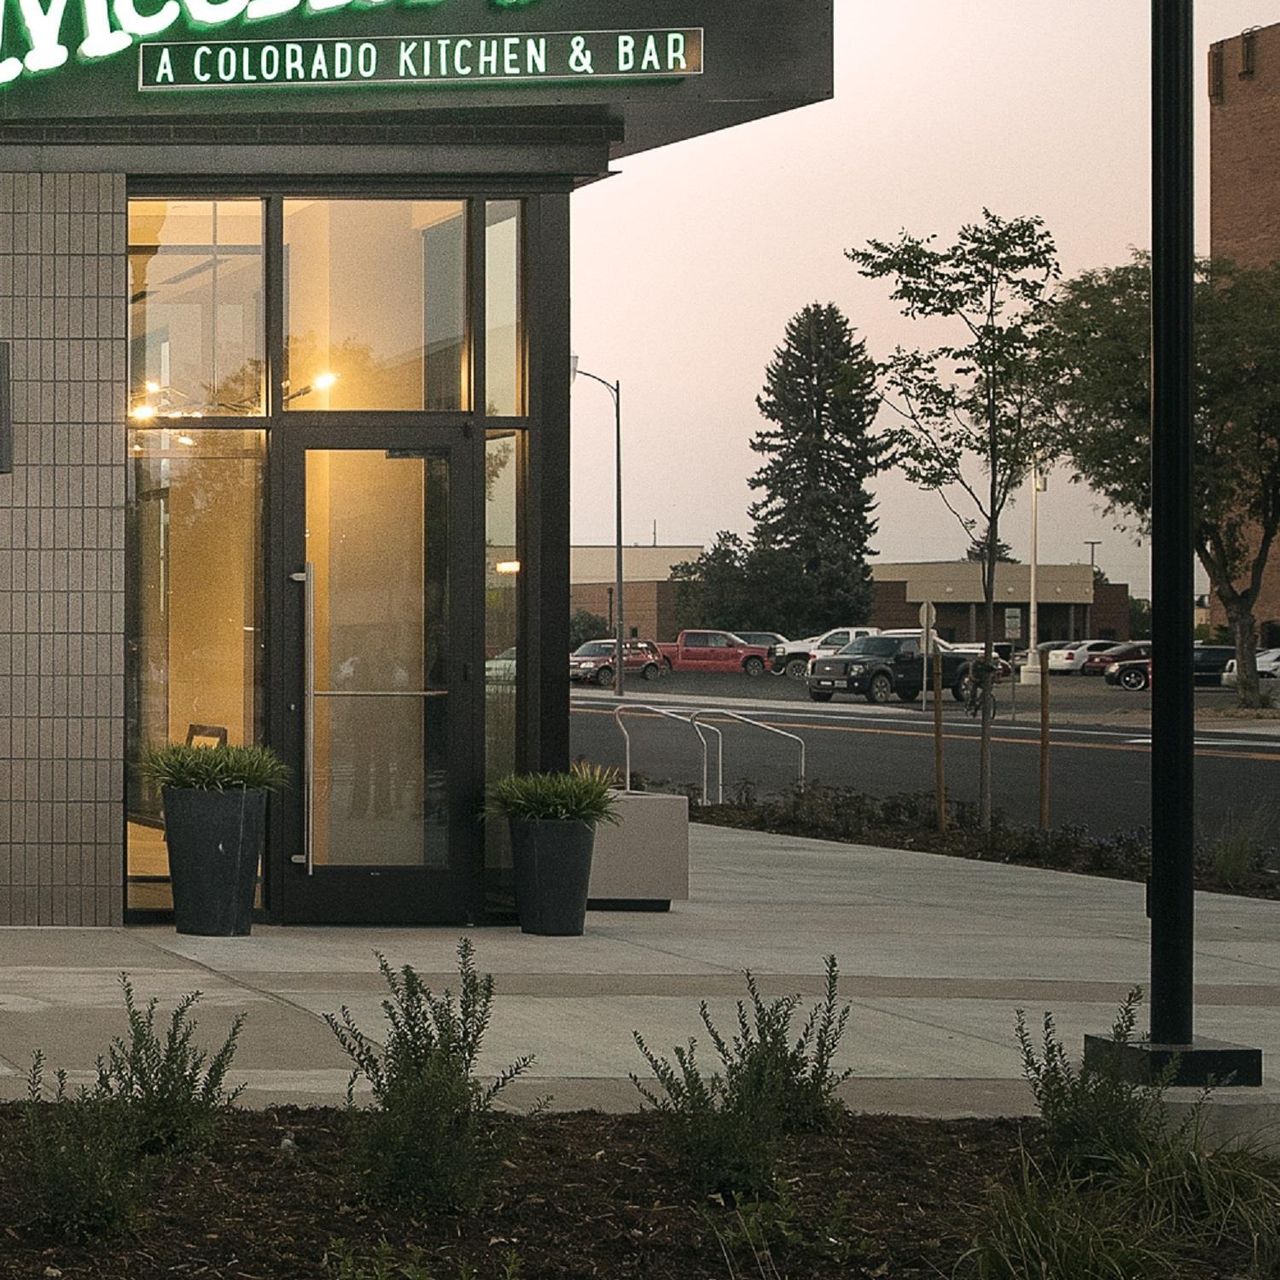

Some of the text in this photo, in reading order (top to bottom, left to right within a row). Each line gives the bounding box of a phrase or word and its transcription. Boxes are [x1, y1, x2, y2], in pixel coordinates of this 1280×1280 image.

[155, 33, 687, 83] A COLORADO KITCHEN & BAR
